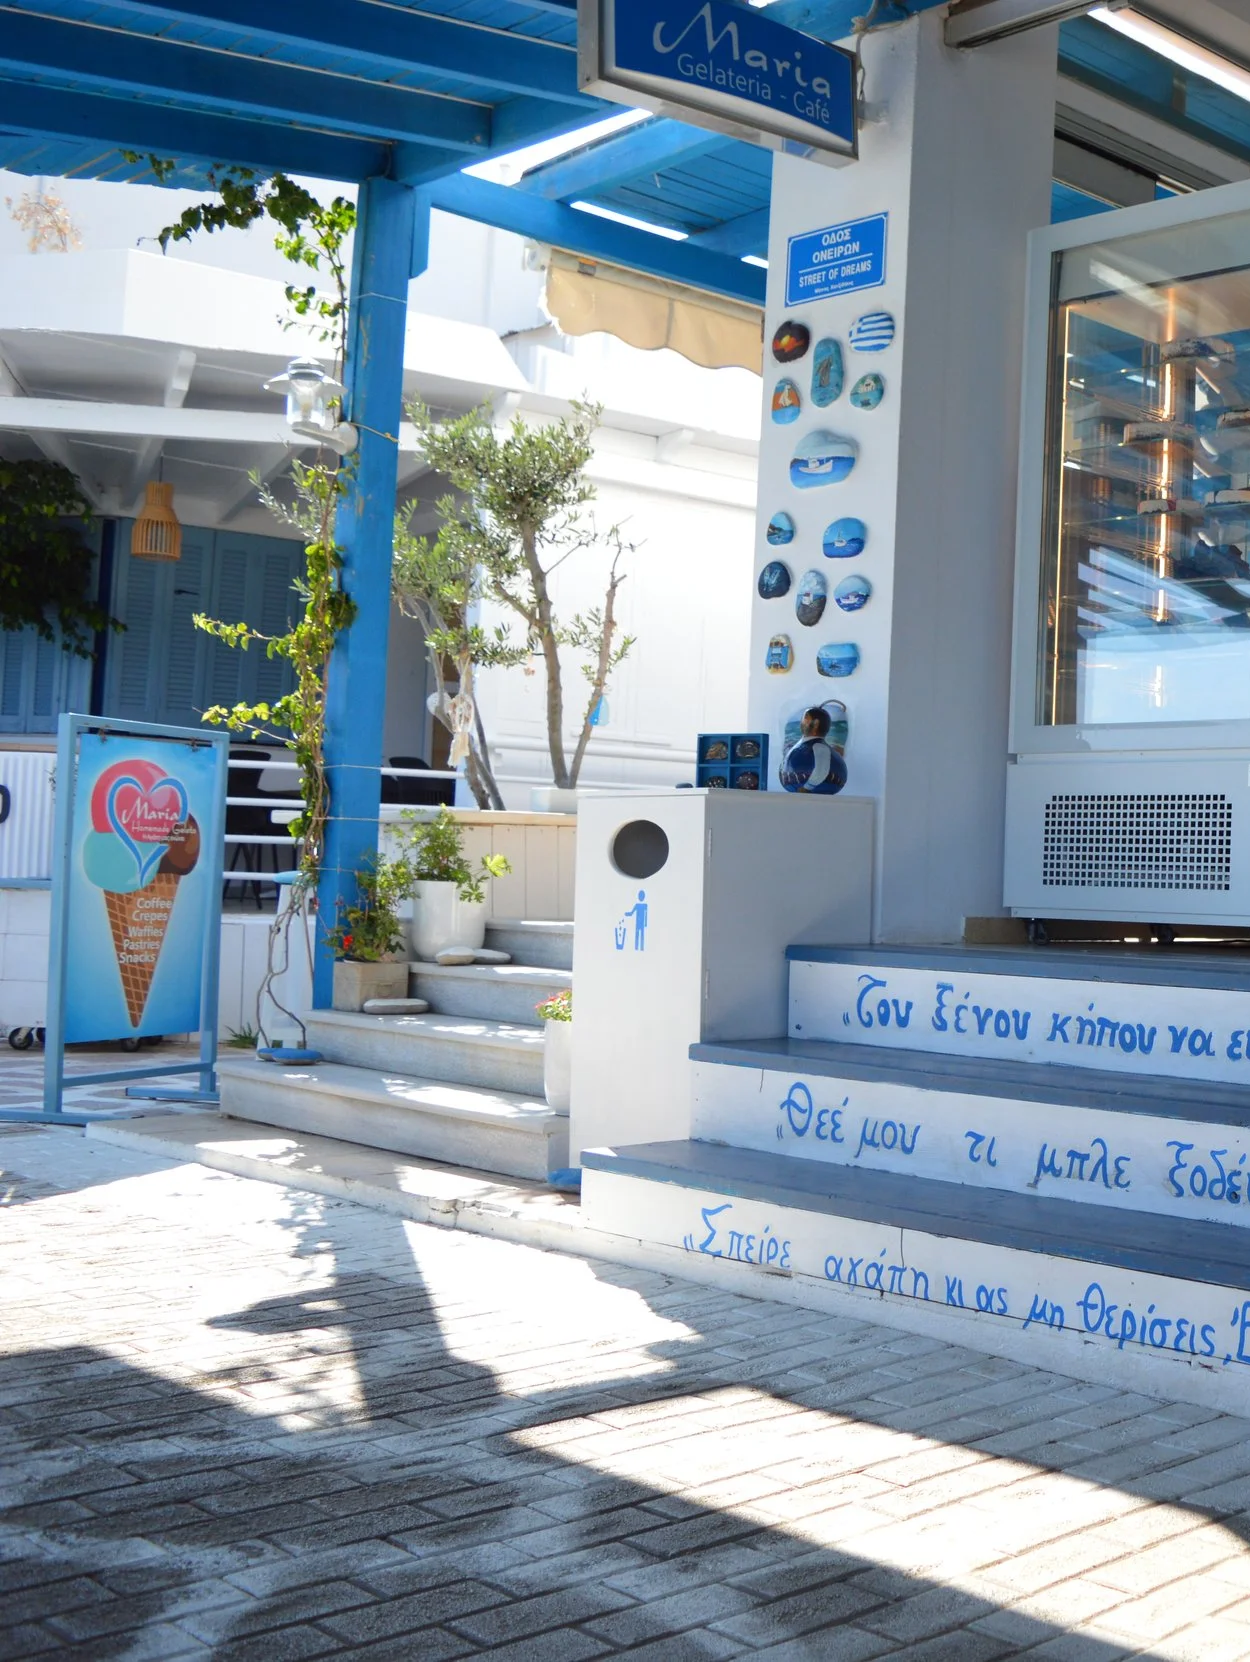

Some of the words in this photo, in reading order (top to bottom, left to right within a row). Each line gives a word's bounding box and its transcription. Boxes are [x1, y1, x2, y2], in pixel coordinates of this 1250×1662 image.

[653, 2, 831, 98] Maria
[677, 53, 772, 100] Gelateria
[793, 92, 830, 125] Café
[822, 228, 852, 246] ΟΔΟΣ
[812, 241, 860, 263] ΟΝΕΙΡΩΝ
[798, 271, 827, 288] STREET
[828, 267, 839, 281] OF
[840, 260, 872, 277] DREAMS
[121, 796, 179, 824] Maria
[136, 897, 173, 909] Coffee
[131, 910, 169, 924] Crepes
[127, 925, 164, 937] Waffles
[123, 938, 161, 951] Pastries
[118, 951, 157, 964] Snacks
[932, 982, 1031, 1040] ξένου
[1046, 1003, 1157, 1055] κήπου
[1168, 1025, 1215, 1056] να
[854, 1115, 921, 1159] μου
[965, 1131, 997, 1167] τι
[1033, 1138, 1132, 1189] μπλε
[824, 1249, 929, 1300] αγάπη
[1022, 1293, 1065, 1332] μη
